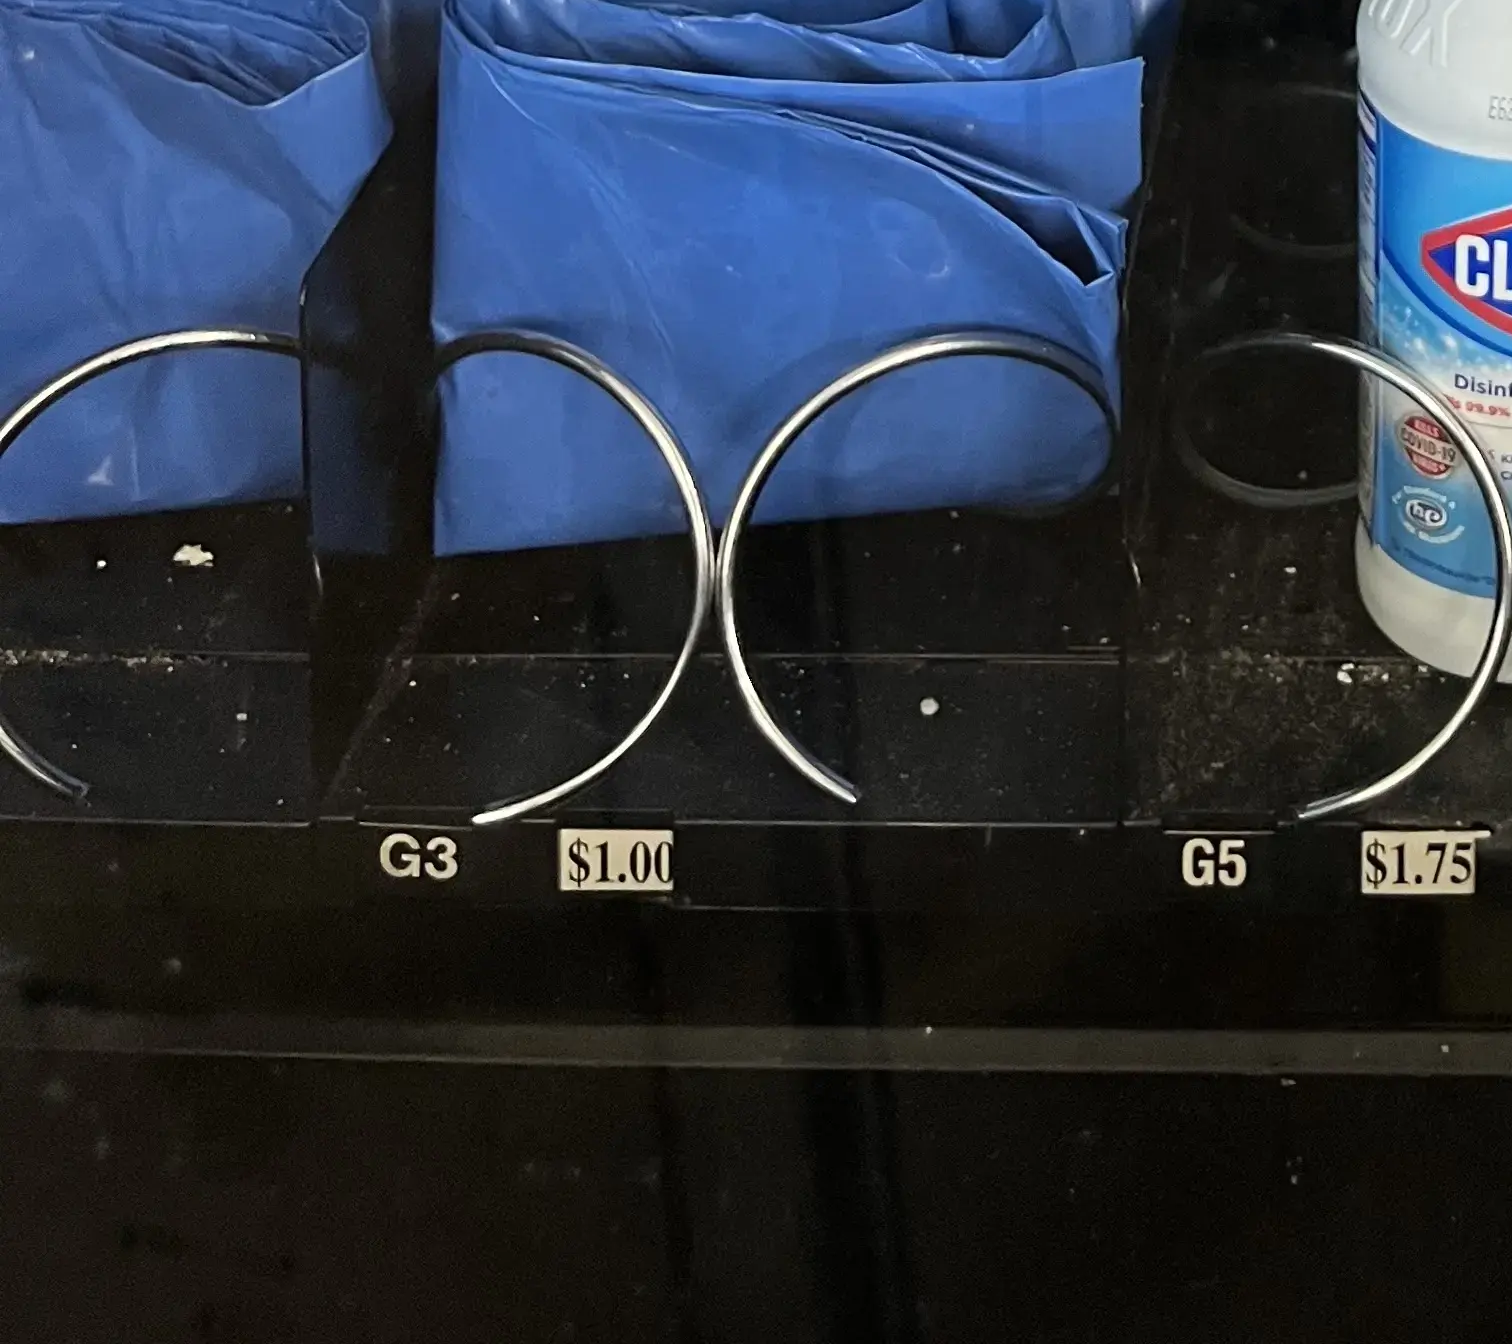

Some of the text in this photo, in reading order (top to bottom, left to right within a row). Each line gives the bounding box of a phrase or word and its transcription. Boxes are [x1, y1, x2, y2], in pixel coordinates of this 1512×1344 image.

[1400, 427, 1457, 463] COVID-19
[380, 833, 458, 880] G3
[567, 837, 674, 888] $1.00
[1181, 838, 1248, 887] G5
[1365, 838, 1473, 890] $1.75
